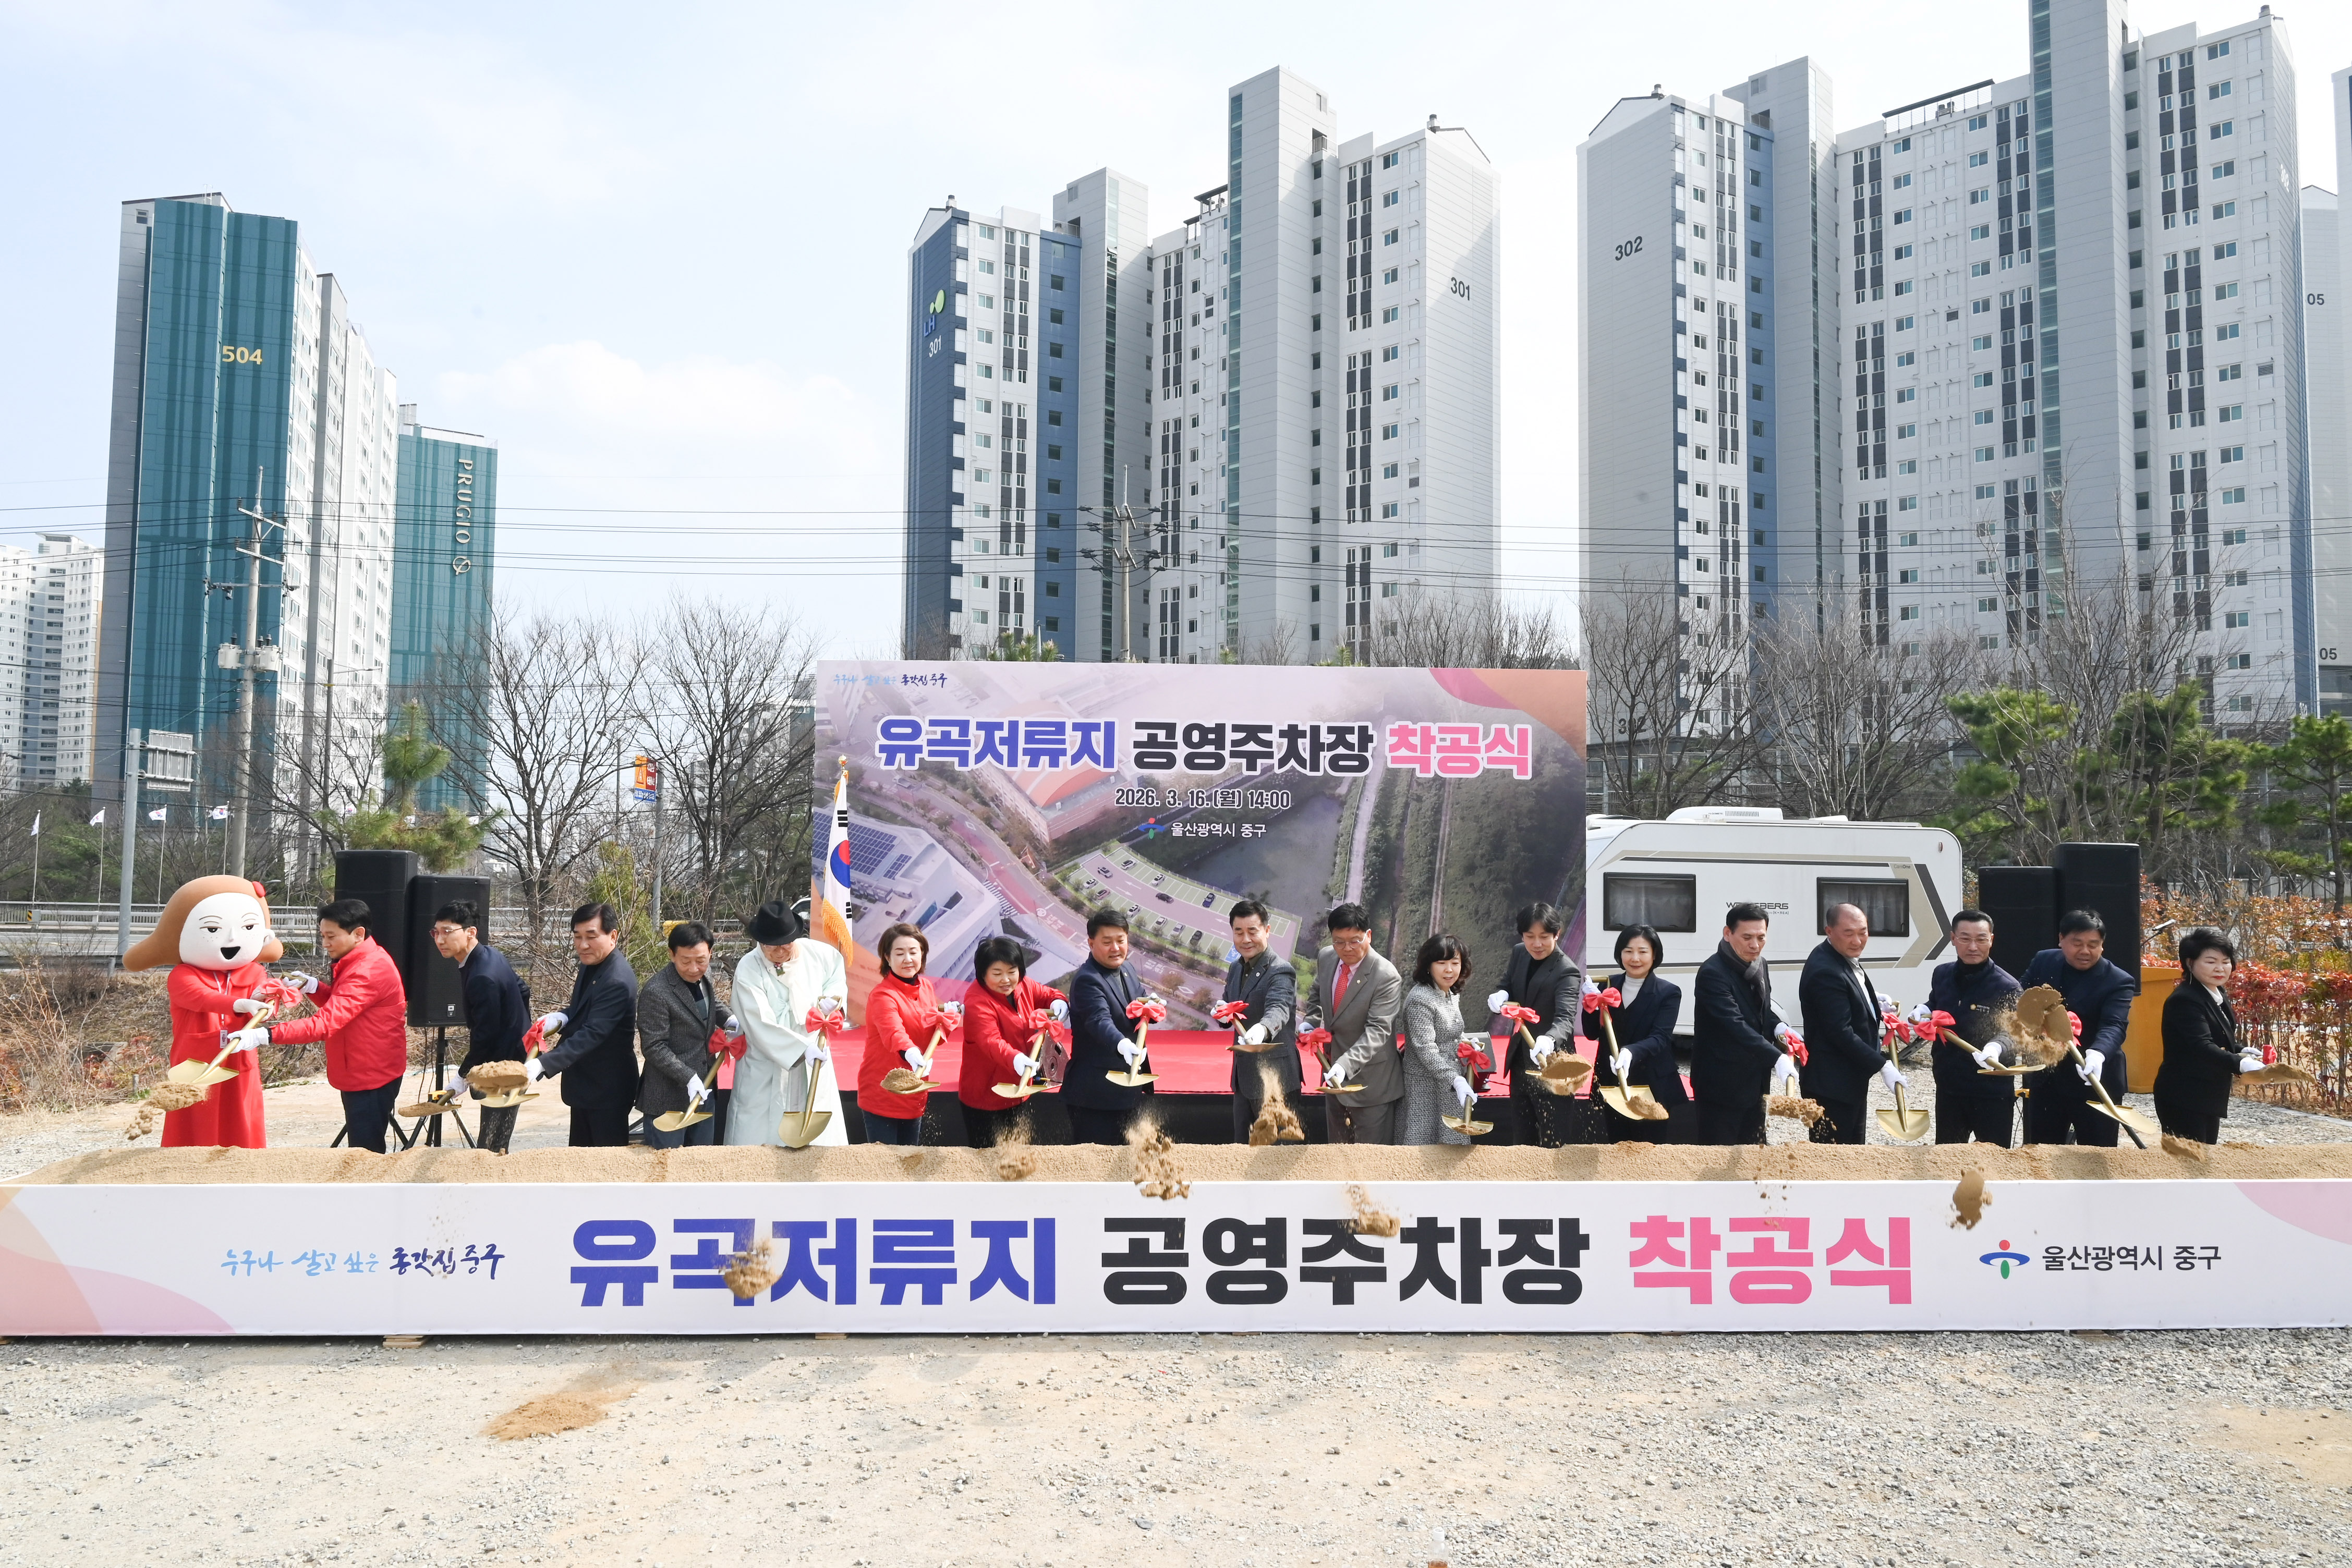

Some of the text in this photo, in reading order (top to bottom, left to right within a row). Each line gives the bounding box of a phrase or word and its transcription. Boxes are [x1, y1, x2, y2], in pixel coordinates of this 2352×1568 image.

[1615, 236, 1643, 261] 302
[1450, 276, 1470, 301] 301
[924, 314, 936, 337] LH
[222, 346, 262, 365] 504
[929, 335, 941, 358] 301
[456, 458, 473, 544] PRUGIO
[833, 673, 948, 688] 누구나 살고 싶은 종갓집 중구
[879, 719, 1529, 776] 유곡저류지 공영주차장 착공식
[1116, 788, 1159, 806] 2026.
[1167, 789, 1181, 806] 3.
[1248, 790, 1291, 809] 14:00
[1171, 822, 1267, 838] 울산광역시 중구
[220, 1244, 505, 1280] 누구나 살고 싶은 종갓집 중구
[571, 1215, 1912, 1307] 유곡저류지 공영주차장 착공식
[2042, 1245, 2222, 1271] 울산광역시 중구
